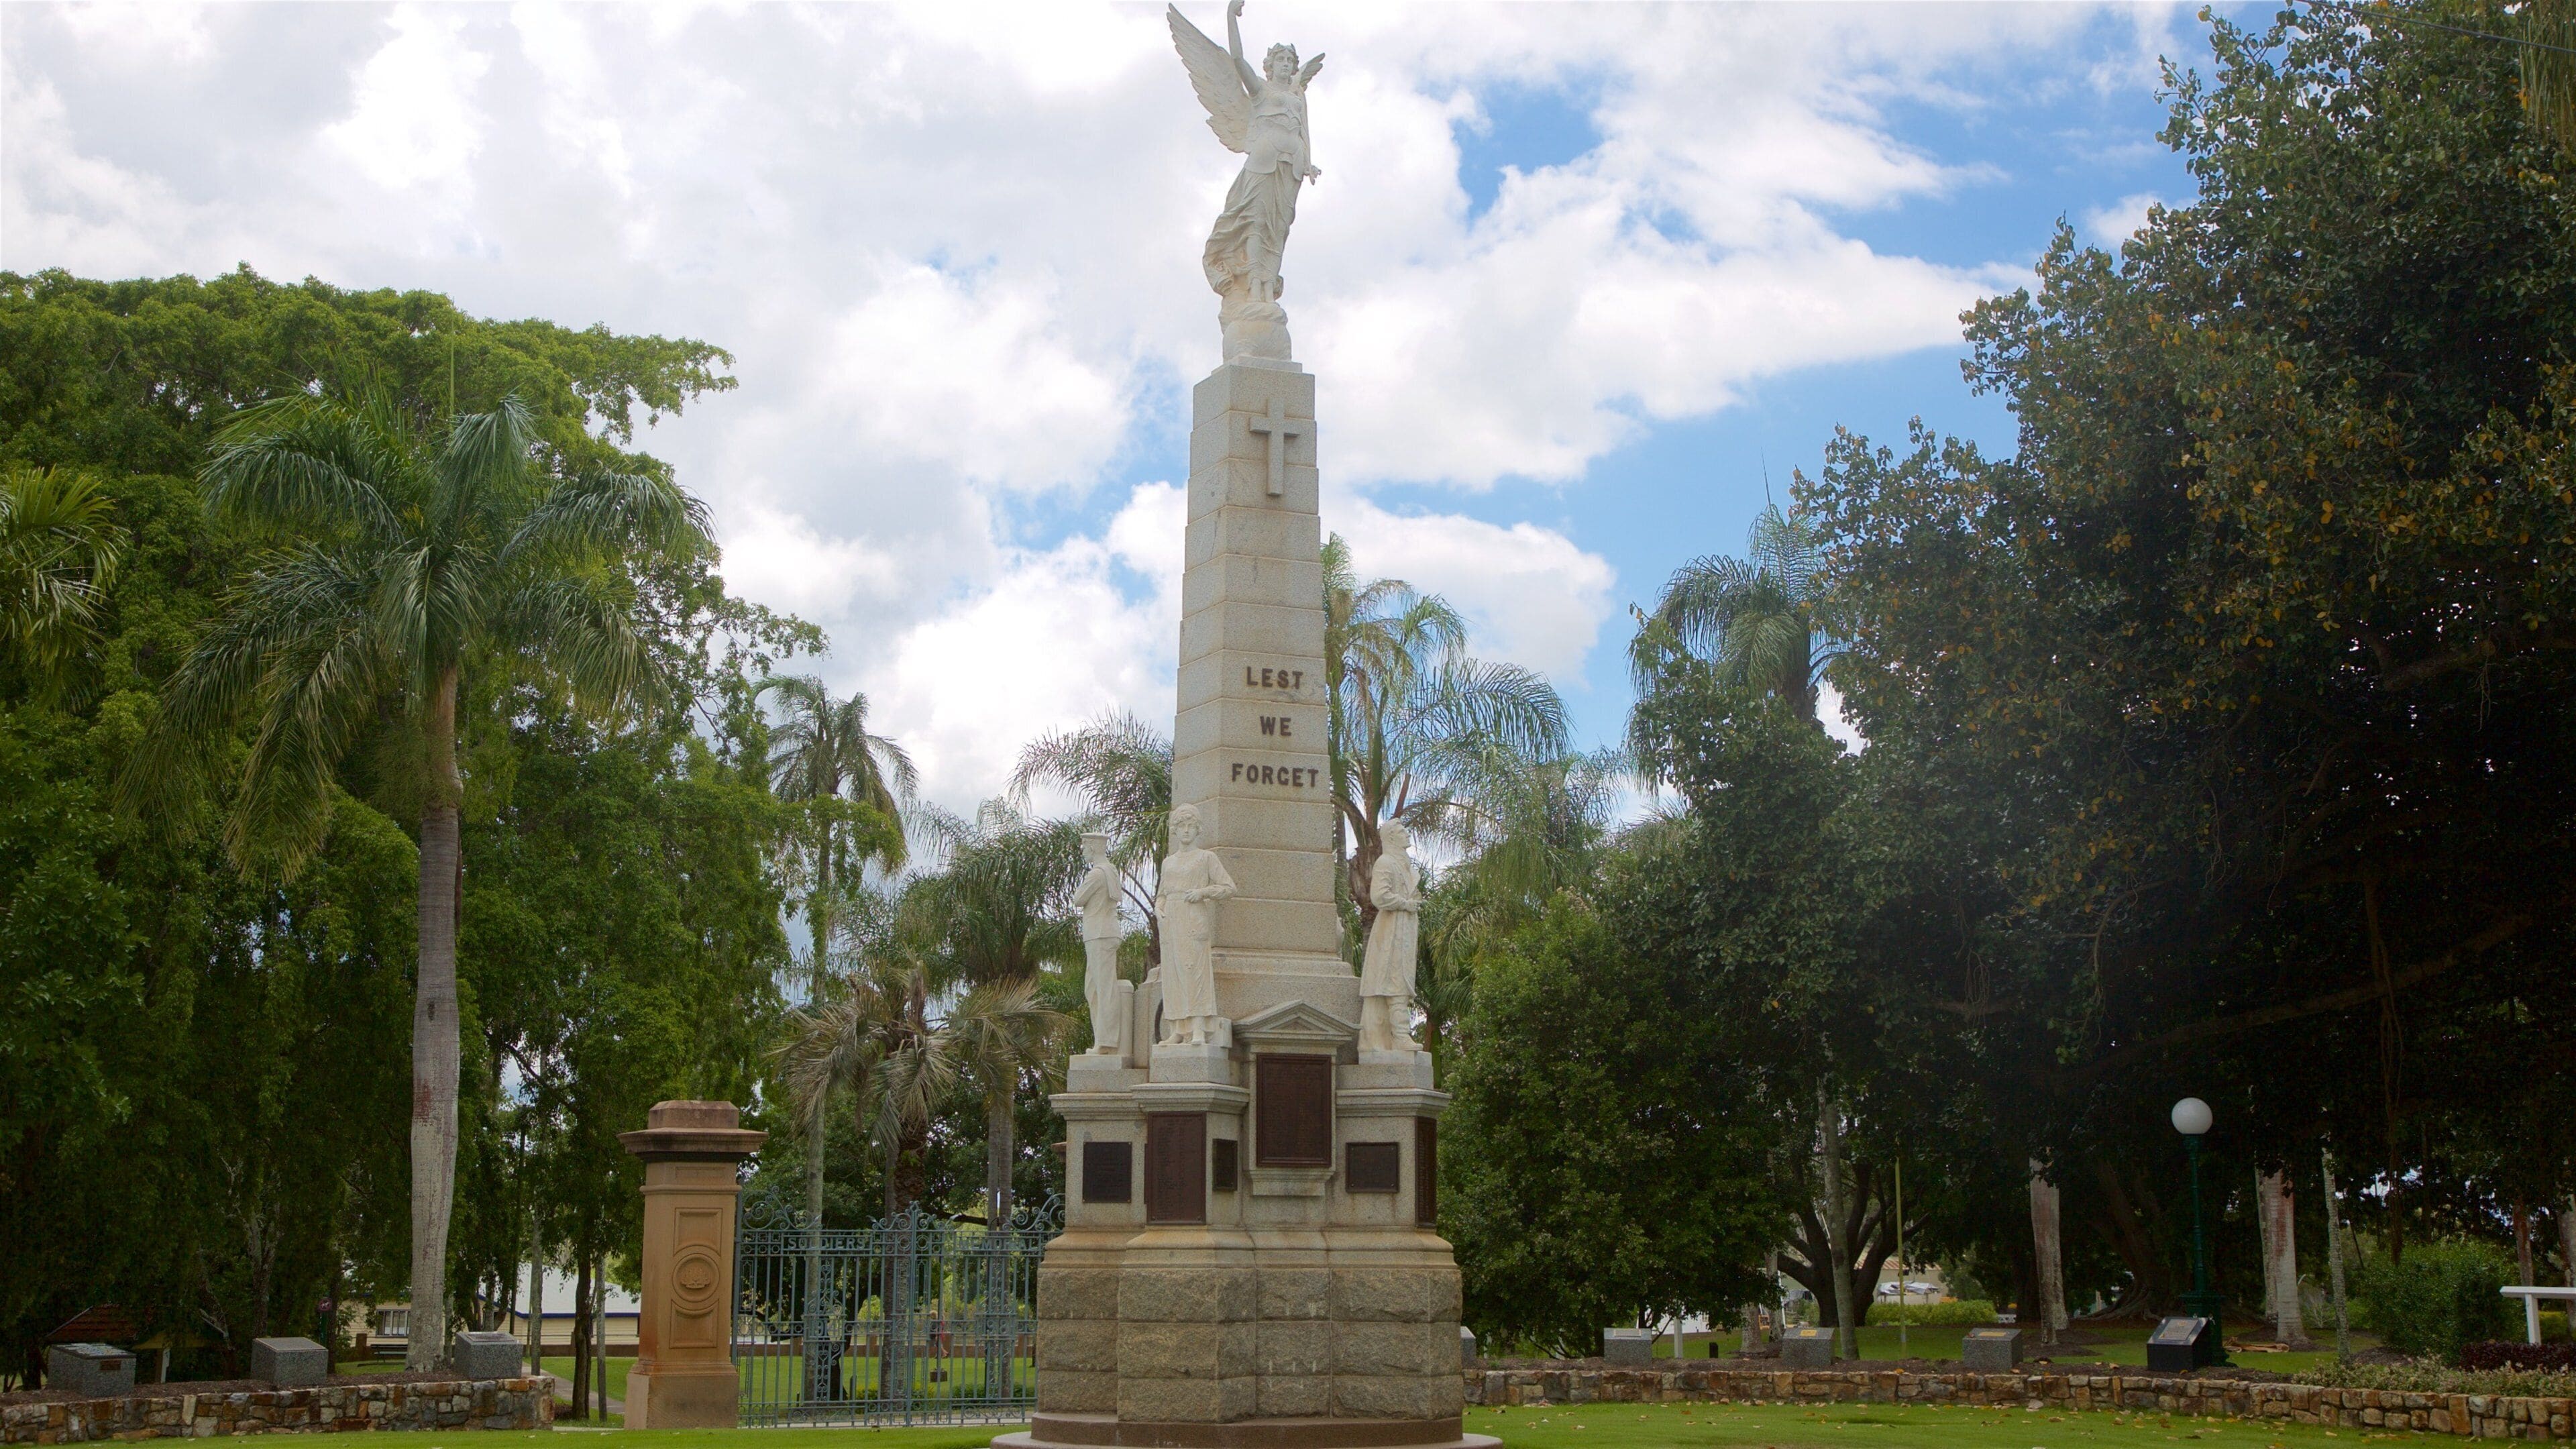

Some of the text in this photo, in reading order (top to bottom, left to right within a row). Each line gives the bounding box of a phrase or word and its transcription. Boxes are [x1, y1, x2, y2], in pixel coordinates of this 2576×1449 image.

[1246, 666, 1303, 689] LEST
[1260, 716, 1291, 737] WE
[1232, 763, 1319, 788] FORGET
[788, 1238, 865, 1249] SOLDIERS
